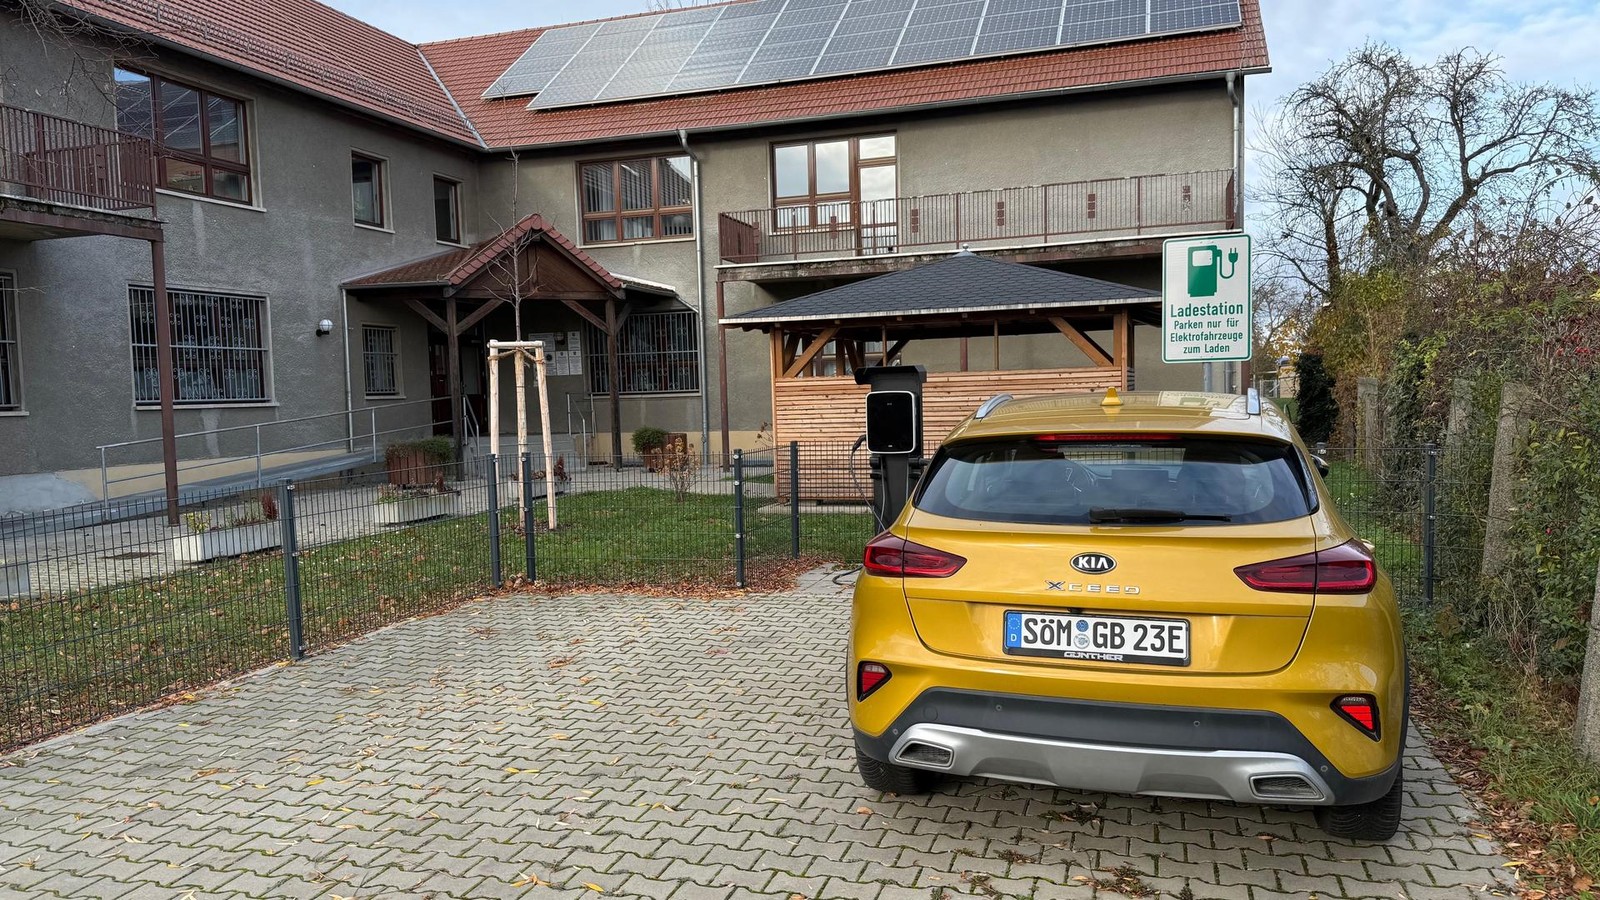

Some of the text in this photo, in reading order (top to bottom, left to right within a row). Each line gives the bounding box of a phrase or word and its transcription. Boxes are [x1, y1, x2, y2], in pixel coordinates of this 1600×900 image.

[1170, 302, 1243, 317] Ladestation
[1174, 318, 1239, 330] Parken nur für
[1170, 332, 1243, 343] Elektrofahrzeuge
[1204, 344, 1230, 354] Laden
[1077, 556, 1109, 569] KIA
[1044, 580, 1140, 595] XCEED
[1010, 634, 1017, 642] D
[1092, 622, 1126, 650] GB
[1133, 624, 1184, 654] 23E
